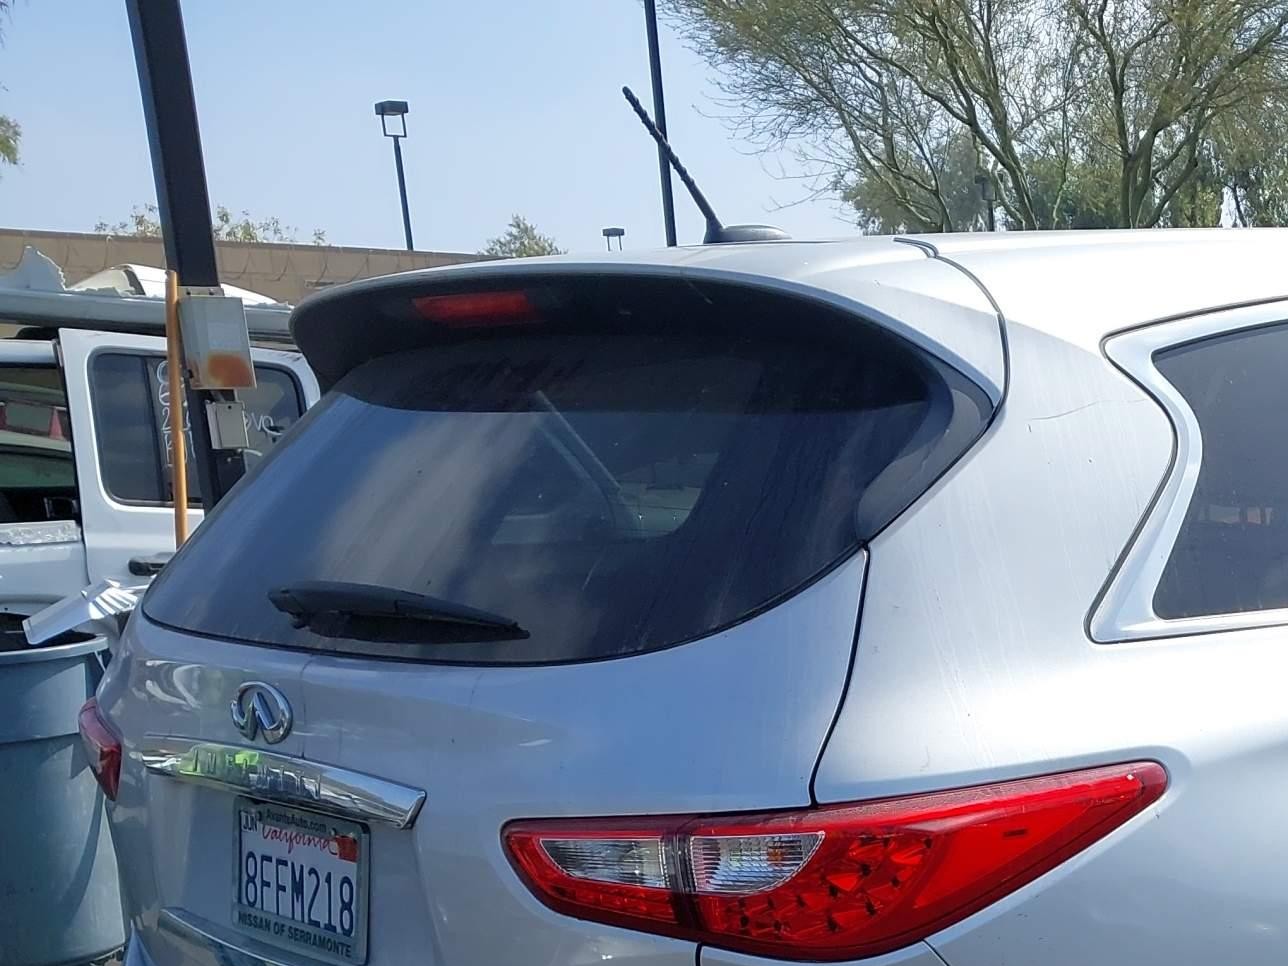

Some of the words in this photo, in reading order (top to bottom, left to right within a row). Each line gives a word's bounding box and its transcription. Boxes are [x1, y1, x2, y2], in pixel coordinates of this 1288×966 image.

[245, 850, 354, 937] 8FFM218
[238, 910, 272, 934] NISSAN
[273, 921, 286, 938] OF
[287, 927, 352, 959] SERRAMONTE
